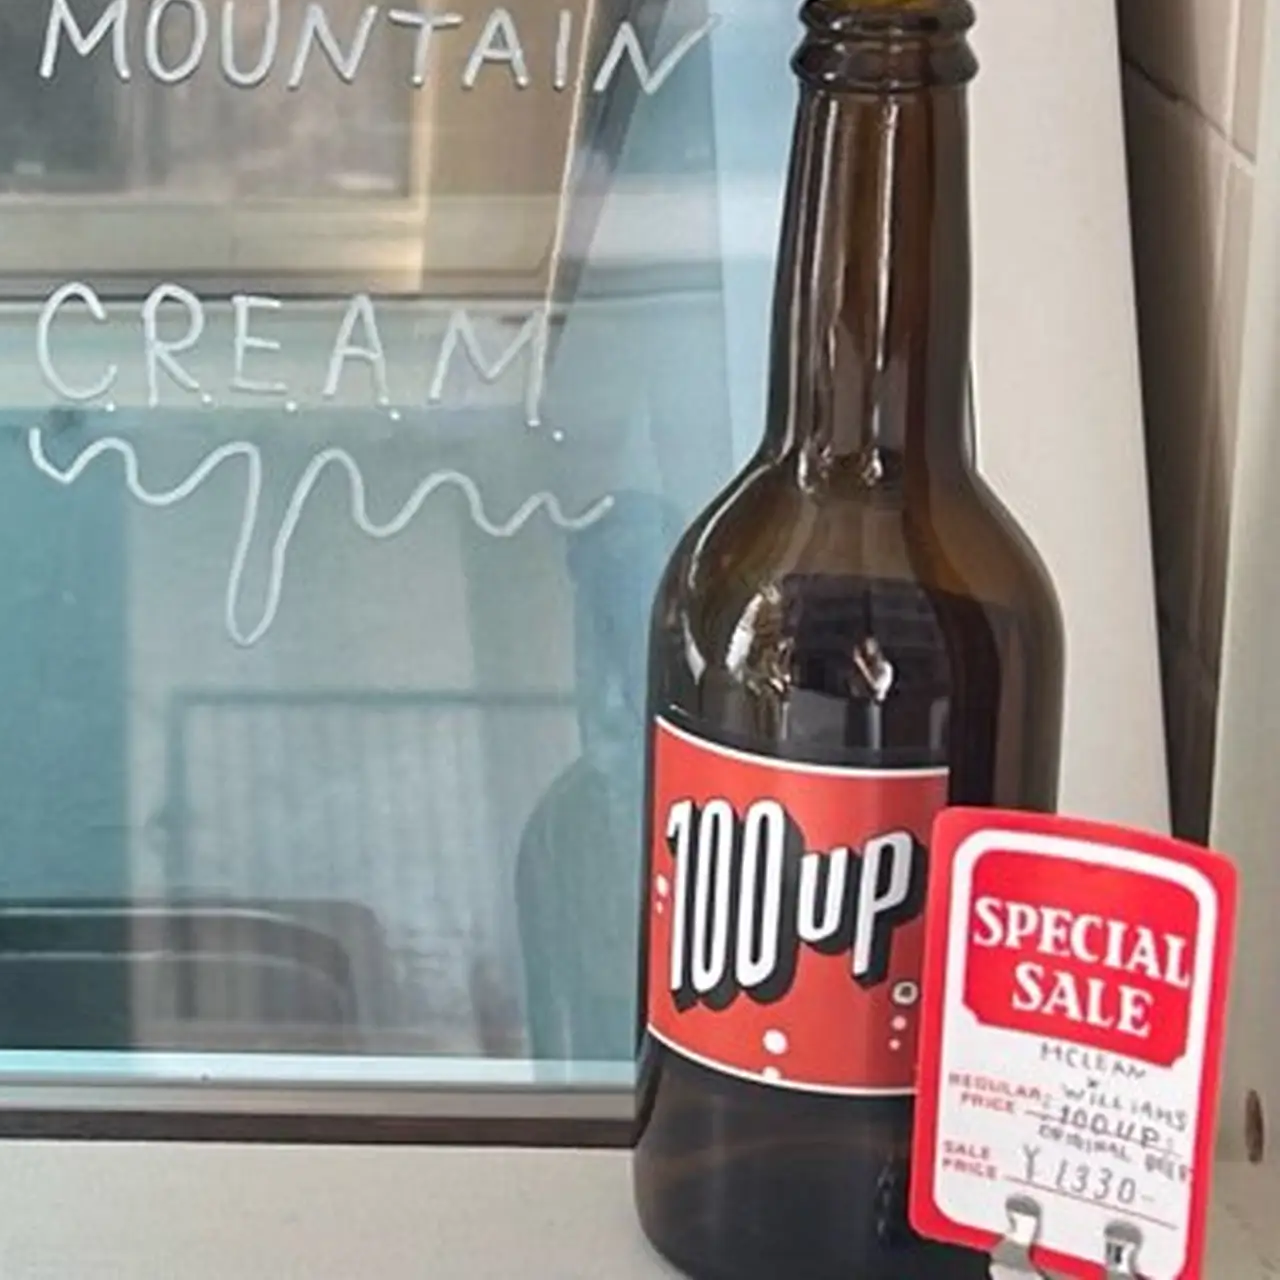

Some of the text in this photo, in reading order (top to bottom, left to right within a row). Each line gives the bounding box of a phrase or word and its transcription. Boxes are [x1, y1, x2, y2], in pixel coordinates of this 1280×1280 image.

[973, 896, 1191, 989] SPECIAL
[1012, 963, 1154, 1037] SALE
[962, 1091, 1015, 1113] PRICE
[945, 1140, 990, 1159] SALE
[942, 1159, 997, 1180] PRICE
